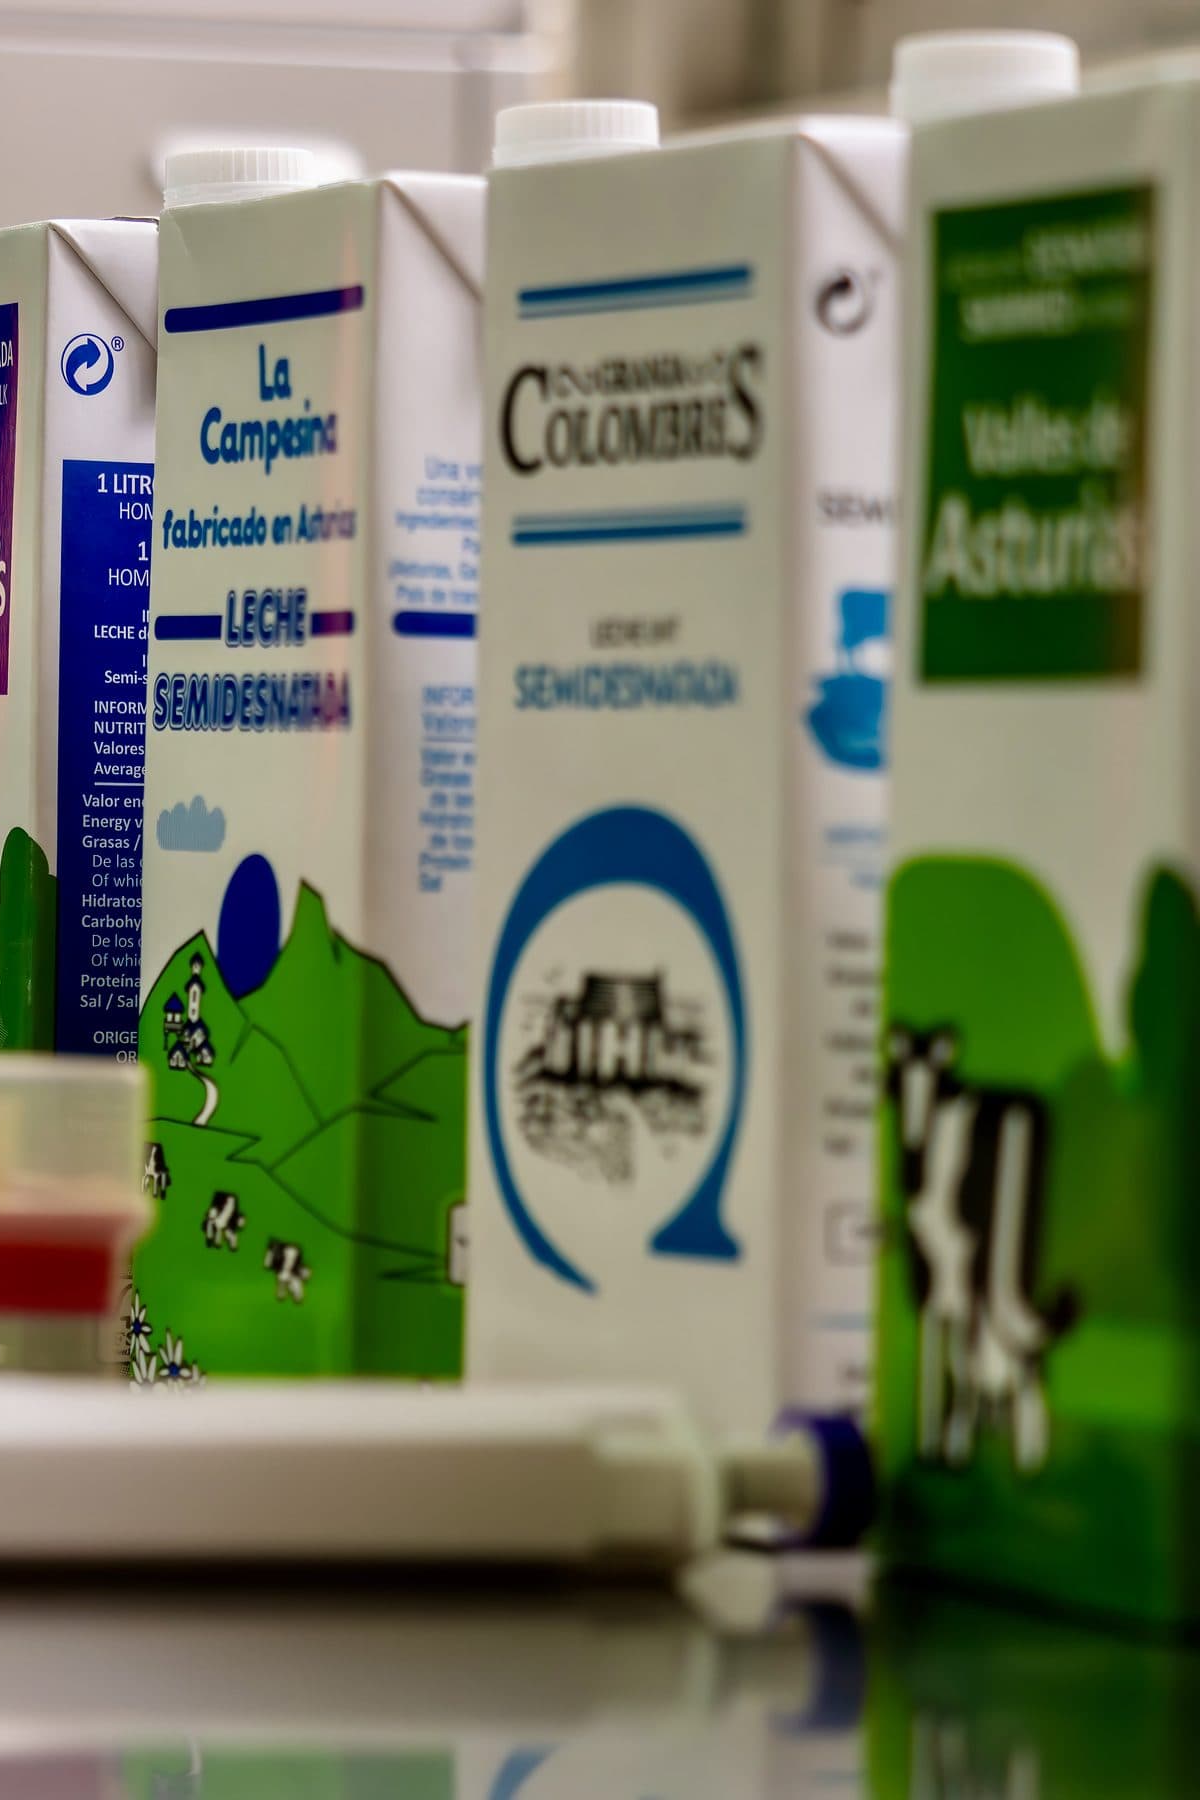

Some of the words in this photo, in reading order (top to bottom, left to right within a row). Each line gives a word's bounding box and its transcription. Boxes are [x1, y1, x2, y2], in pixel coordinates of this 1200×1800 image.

[258, 343, 291, 401] La
[97, 473, 108, 493] 1
[113, 473, 154, 495] LITR
[162, 505, 267, 550] fabricado
[271, 515, 293, 545] en
[138, 541, 149, 561] 1
[225, 587, 308, 648] LECHE
[94, 625, 135, 639] LECHE
[153, 670, 352, 733] SEMIDESNATADA
[94, 741, 145, 755] Valores
[82, 794, 119, 808] Valor
[82, 815, 131, 832] Energy
[82, 835, 130, 849] Grasas
[92, 854, 112, 868] De
[116, 853, 135, 868] las
[92, 873, 109, 887] Of
[81, 894, 142, 908] Hidratos
[92, 934, 111, 948] De
[114, 934, 134, 948] los
[91, 953, 108, 967] Of
[80, 994, 102, 1008] Sal
